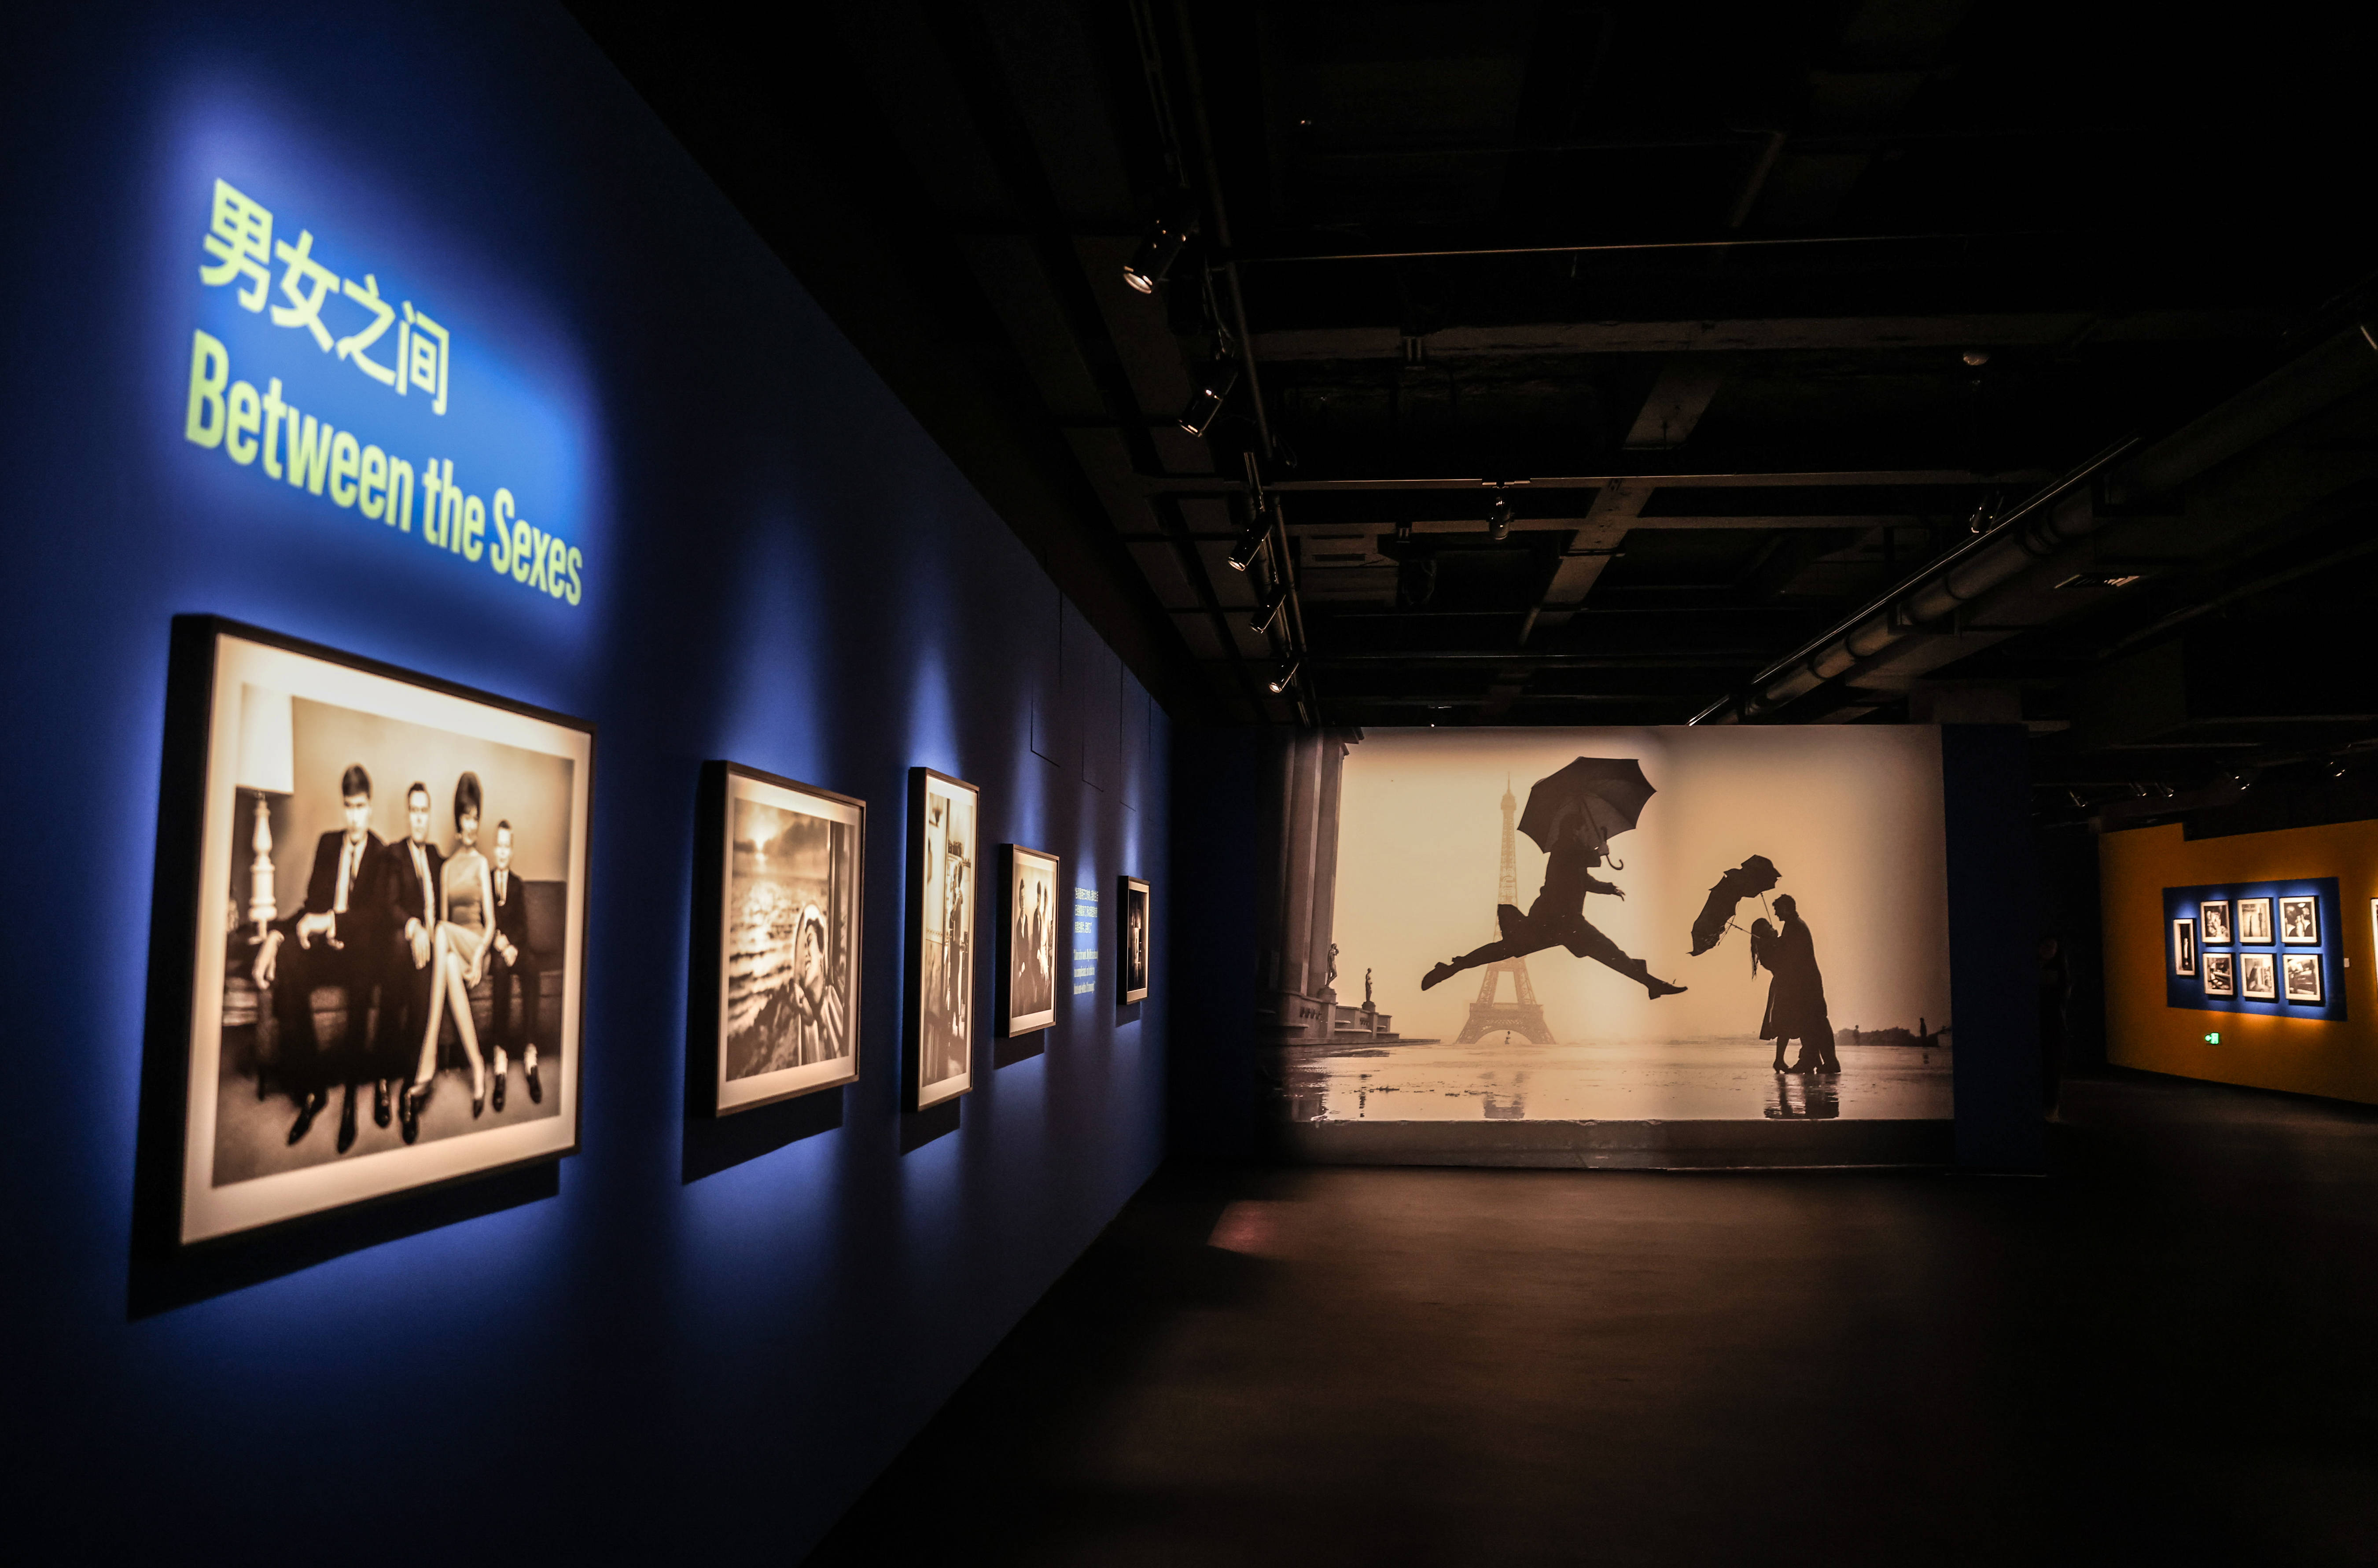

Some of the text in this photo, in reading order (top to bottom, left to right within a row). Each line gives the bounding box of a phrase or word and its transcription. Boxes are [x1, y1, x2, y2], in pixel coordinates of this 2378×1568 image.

[199, 177, 449, 416] 男女之间
[185, 328, 582, 606] Between the Sexes
